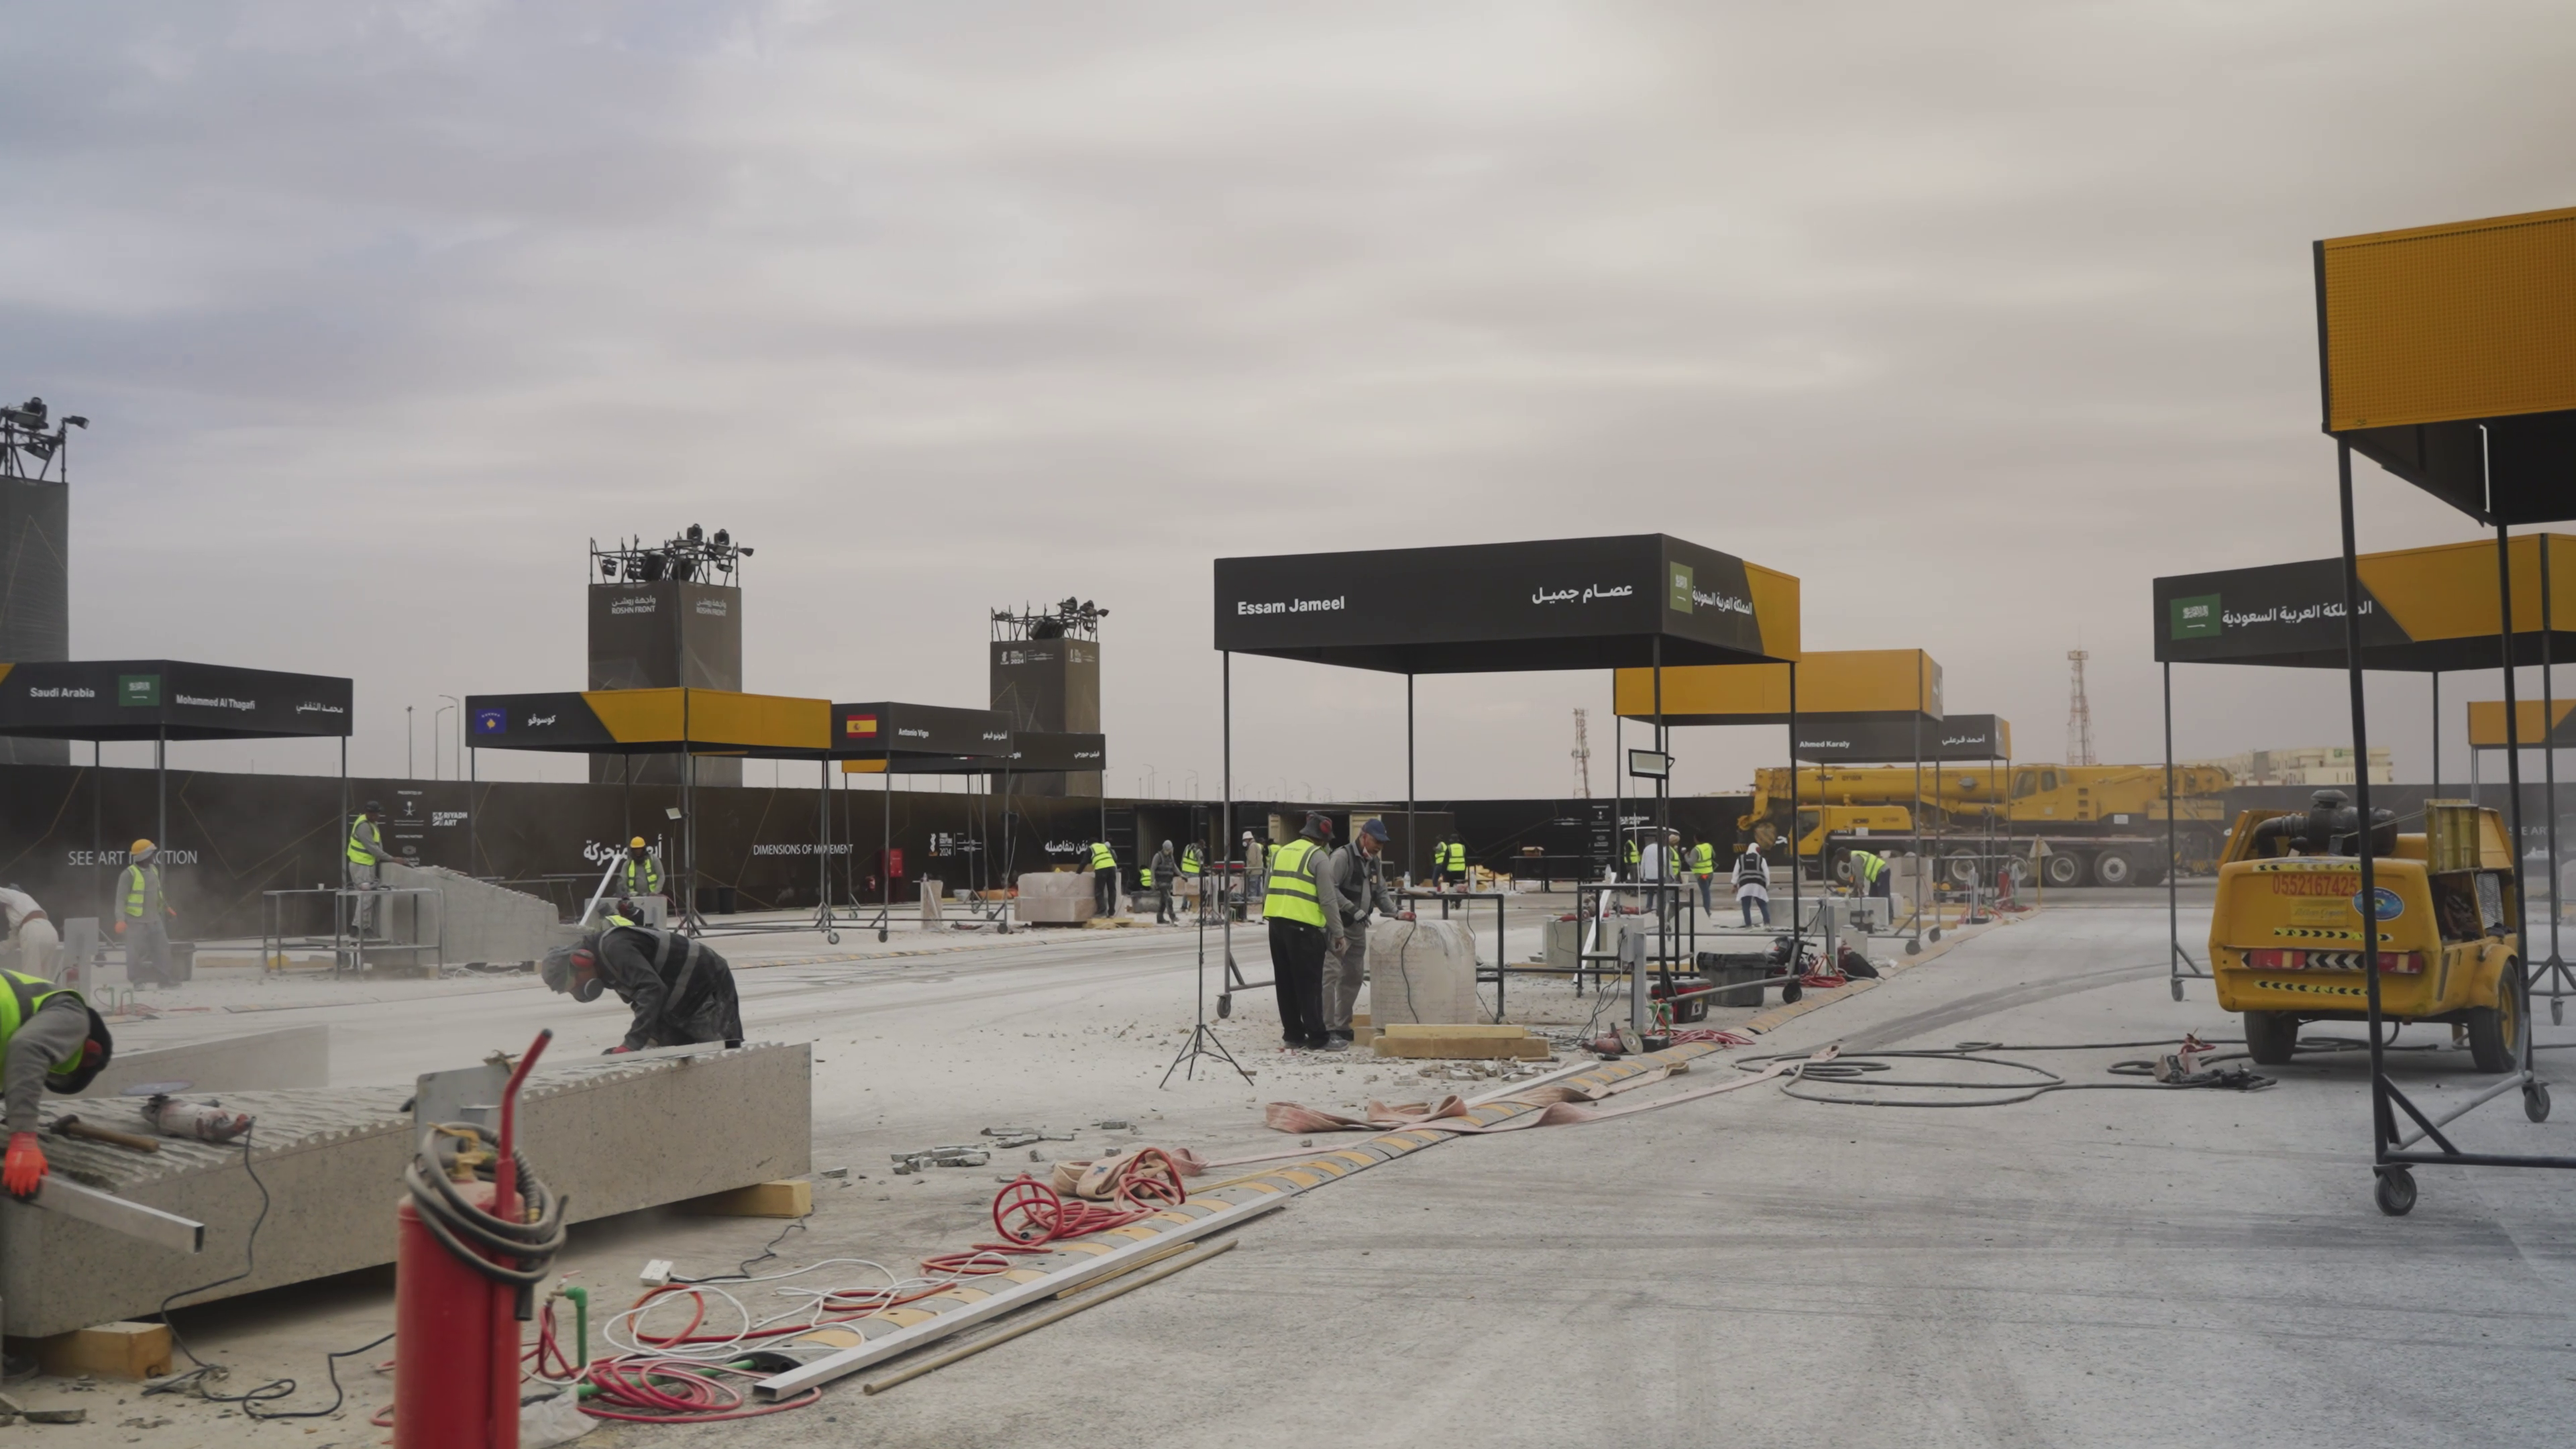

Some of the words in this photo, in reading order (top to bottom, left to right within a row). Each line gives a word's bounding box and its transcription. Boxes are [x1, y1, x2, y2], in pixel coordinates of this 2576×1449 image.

[1532, 586, 1580, 604] جميل
[1582, 584, 1633, 603] عصام
[1693, 586, 1716, 607] السعودية
[1716, 592, 1733, 612] العربية
[635, 604, 656, 613] FRONT
[1237, 601, 1286, 615] Essam
[1288, 595, 1345, 613] Jameel
[1733, 596, 1752, 615] المملكة
[2279, 604, 2320, 624] العربية
[2222, 608, 2277, 627] السعودية
[30, 687, 60, 698] Saudi
[60, 688, 95, 698] Arabia
[176, 694, 219, 707] Mohammed
[219, 698, 227, 708] Al
[1826, 741, 1850, 749] Karaly
[68, 851, 95, 866] SEE
[97, 850, 125, 865] ART
[153, 850, 197, 865] CTION
[753, 844, 801, 856] DIMENSIONS
[801, 844, 812, 855] OF
[2272, 874, 2359, 896] 0552167425
